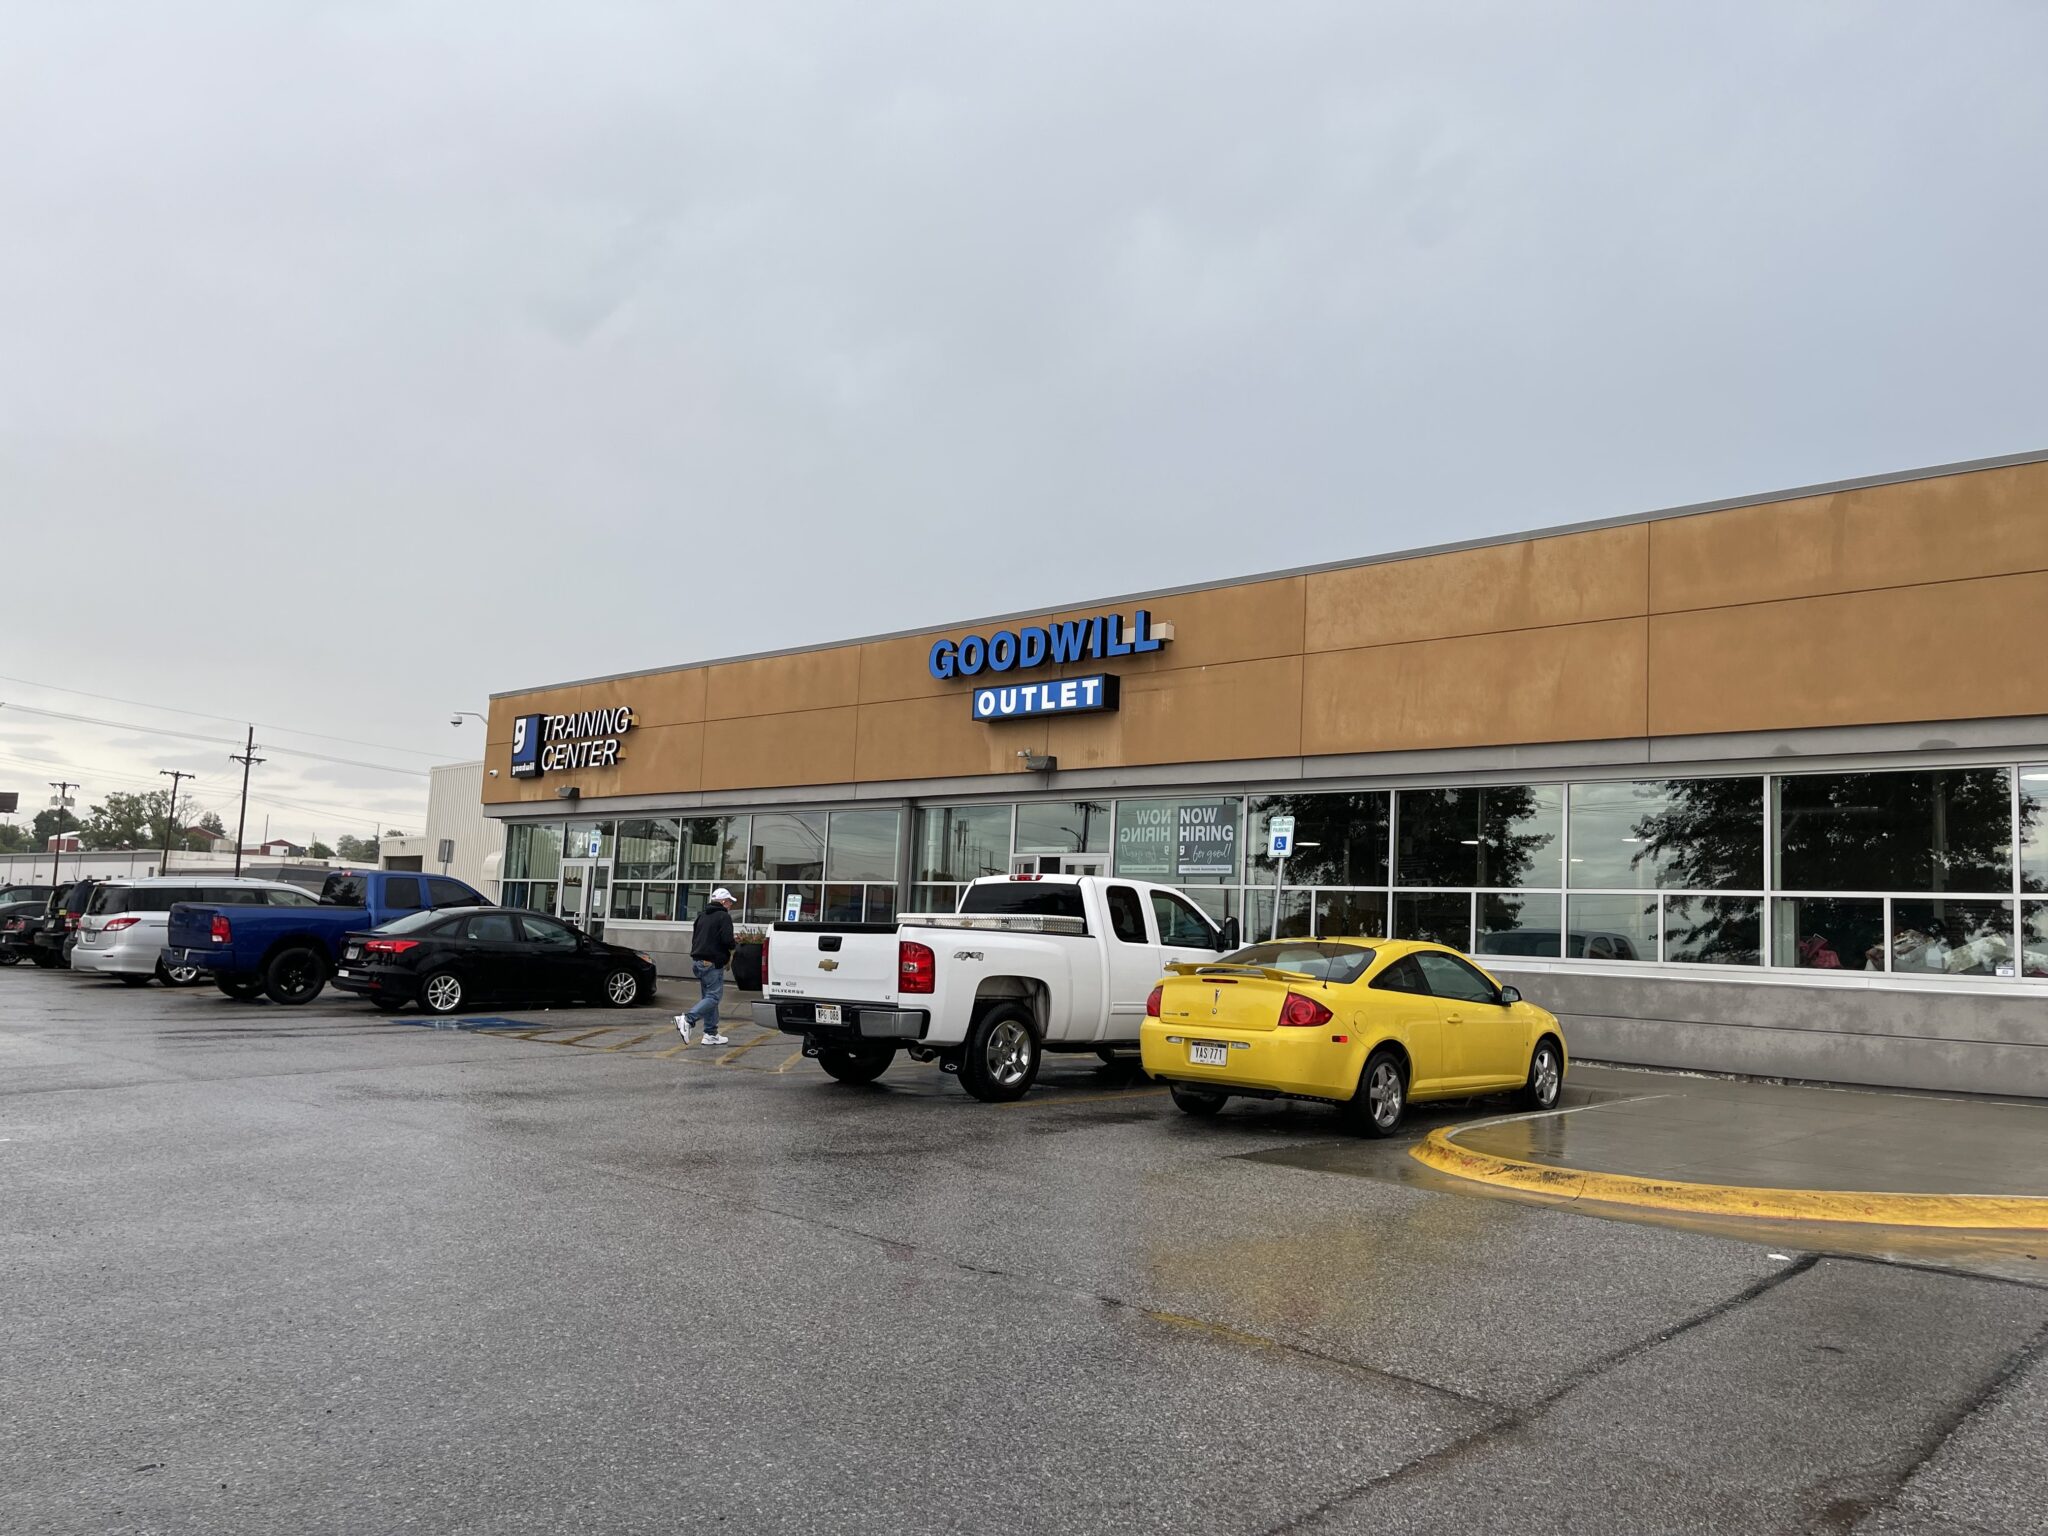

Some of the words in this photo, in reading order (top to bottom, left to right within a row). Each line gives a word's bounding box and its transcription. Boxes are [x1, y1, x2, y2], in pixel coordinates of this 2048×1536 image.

[928, 610, 1162, 680] GOODWILL
[977, 678, 1099, 716] OUTLET
[543, 706, 630, 742] TRAINING
[541, 738, 618, 771] CENTER
[512, 762, 535, 776] goodwill
[1180, 807, 1218, 824] NOW
[1179, 825, 1234, 842] HIRING
[1192, 844, 1205, 863] for
[1195, 1046, 1208, 1060] YAS
[1209, 1047, 1222, 1061] 771
